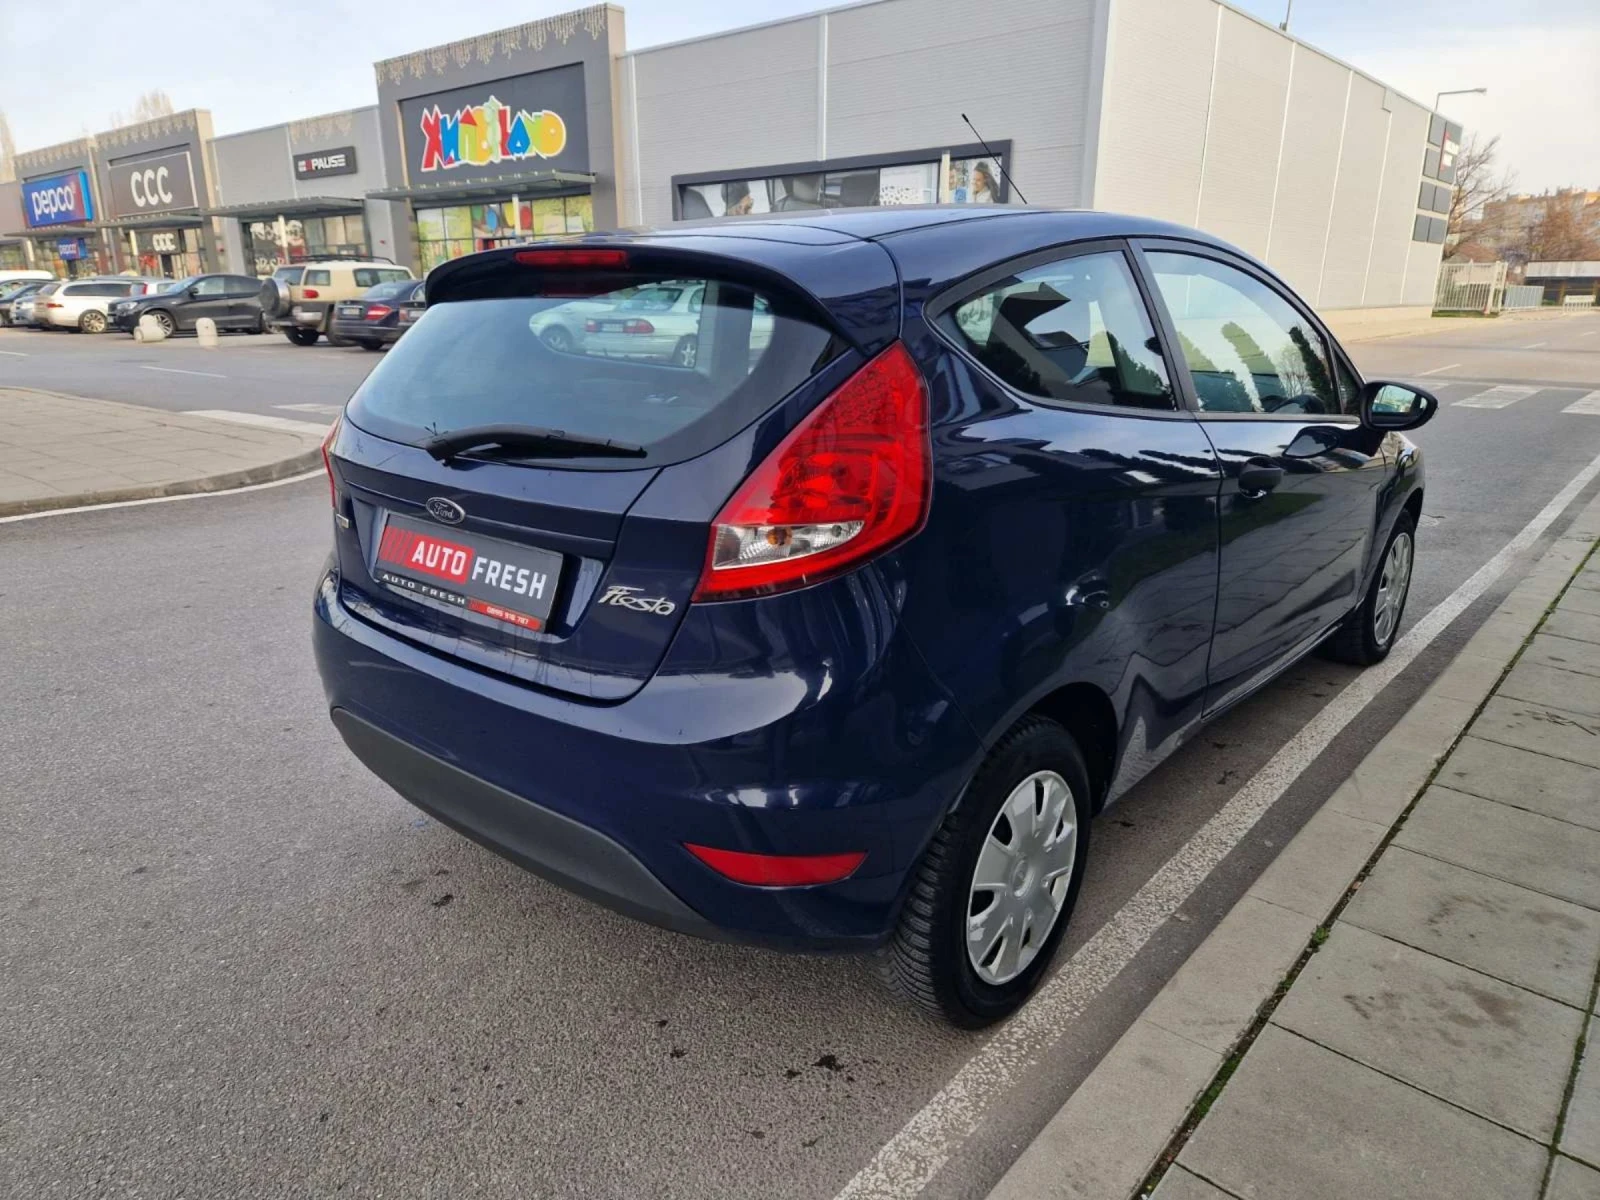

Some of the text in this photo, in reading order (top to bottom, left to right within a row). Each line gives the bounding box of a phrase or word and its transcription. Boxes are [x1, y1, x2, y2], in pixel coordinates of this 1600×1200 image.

[311, 154, 346, 170] PAUSE
[131, 166, 172, 207] CCC
[31, 185, 75, 221] pepco
[152, 233, 175, 251] CCC
[412, 540, 547, 599] AUTO FRESH
[382, 573, 465, 604] AUTO FRESH
[598, 585, 675, 615] Fiesta
